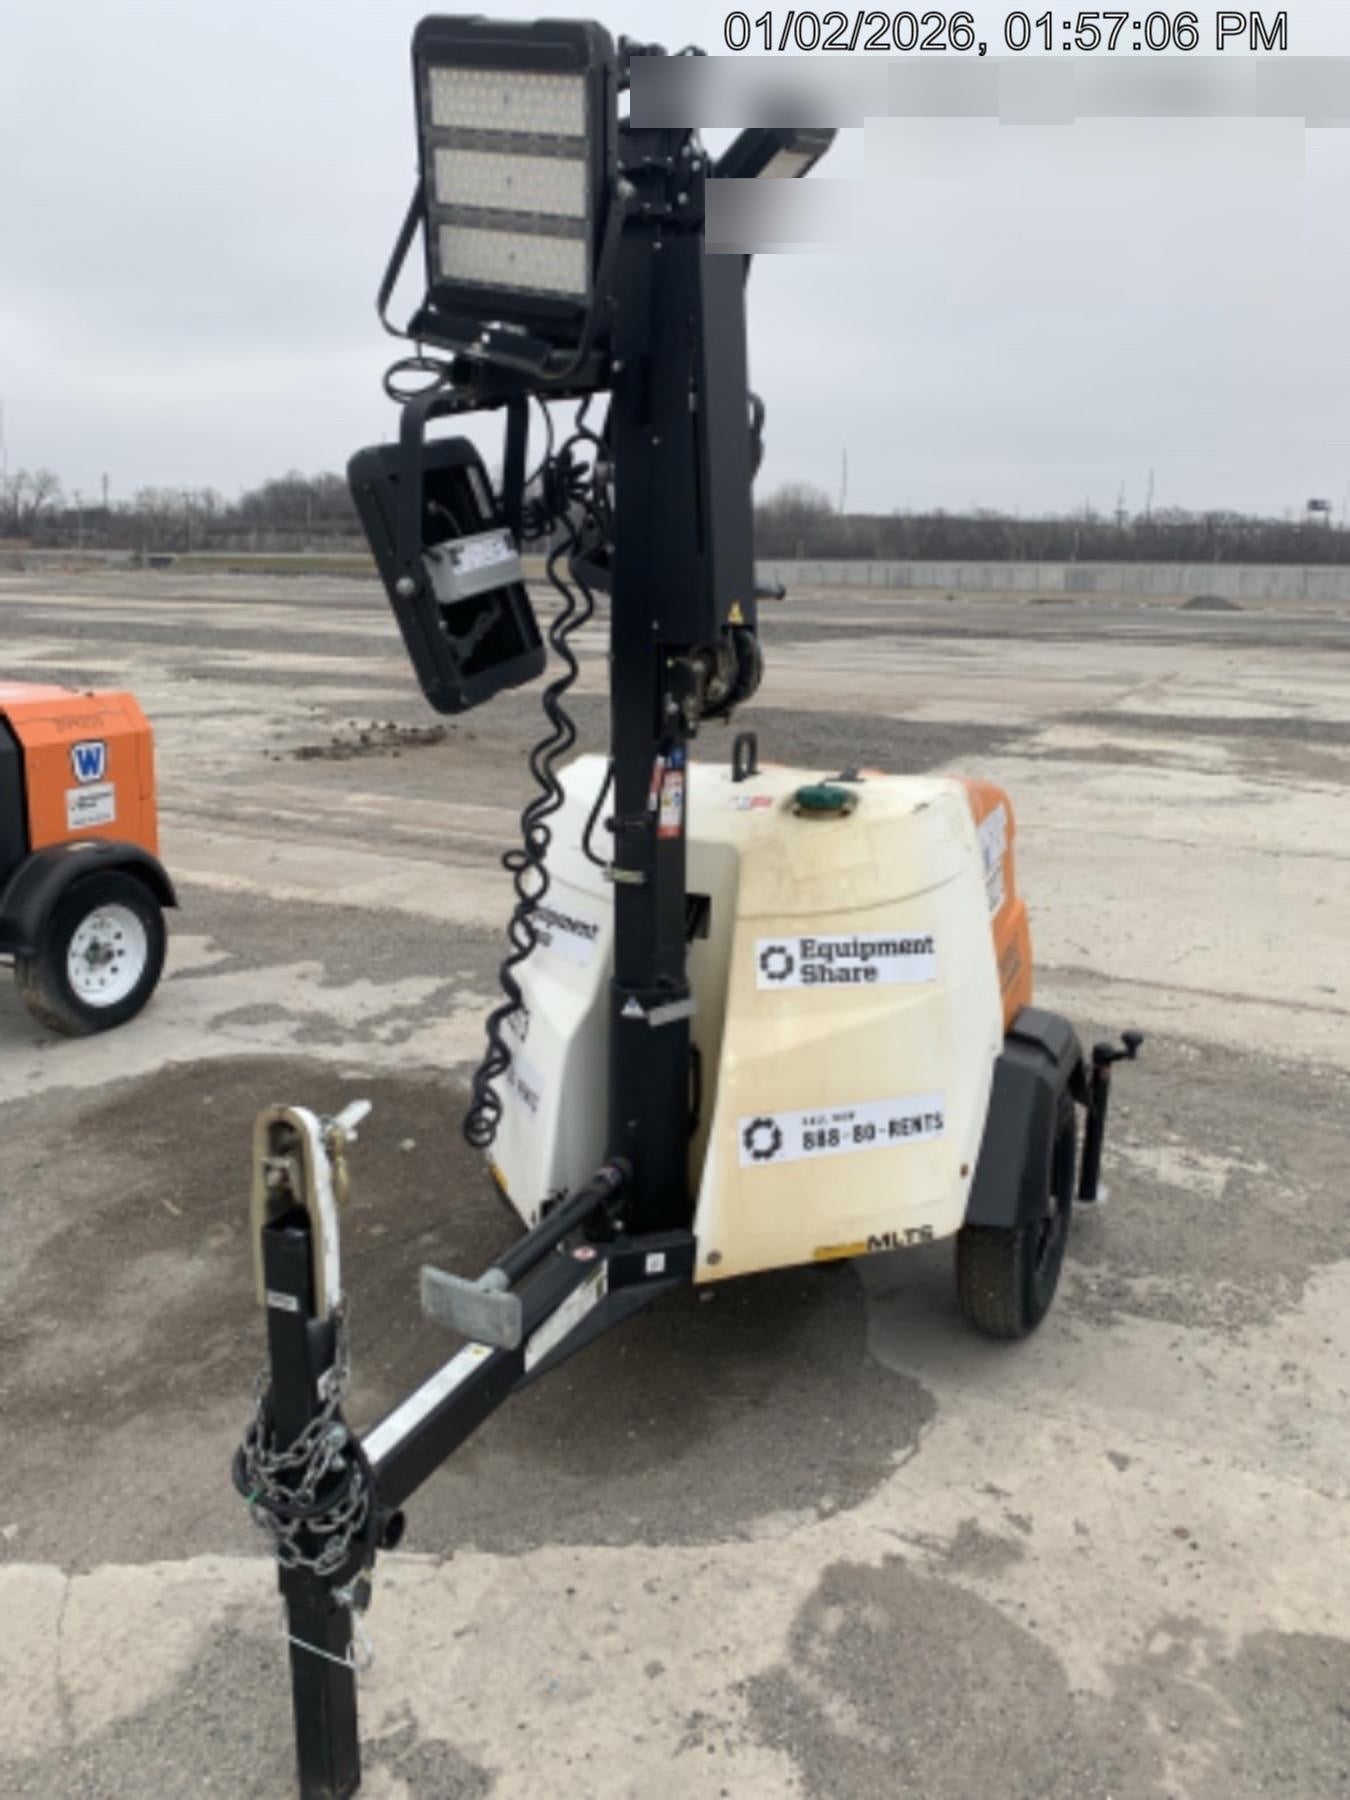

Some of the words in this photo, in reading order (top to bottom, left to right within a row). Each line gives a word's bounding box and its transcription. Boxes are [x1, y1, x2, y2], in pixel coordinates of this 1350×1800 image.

[75, 745, 102, 777] W
[799, 935, 935, 961] Equipment
[800, 964, 878, 984] Share
